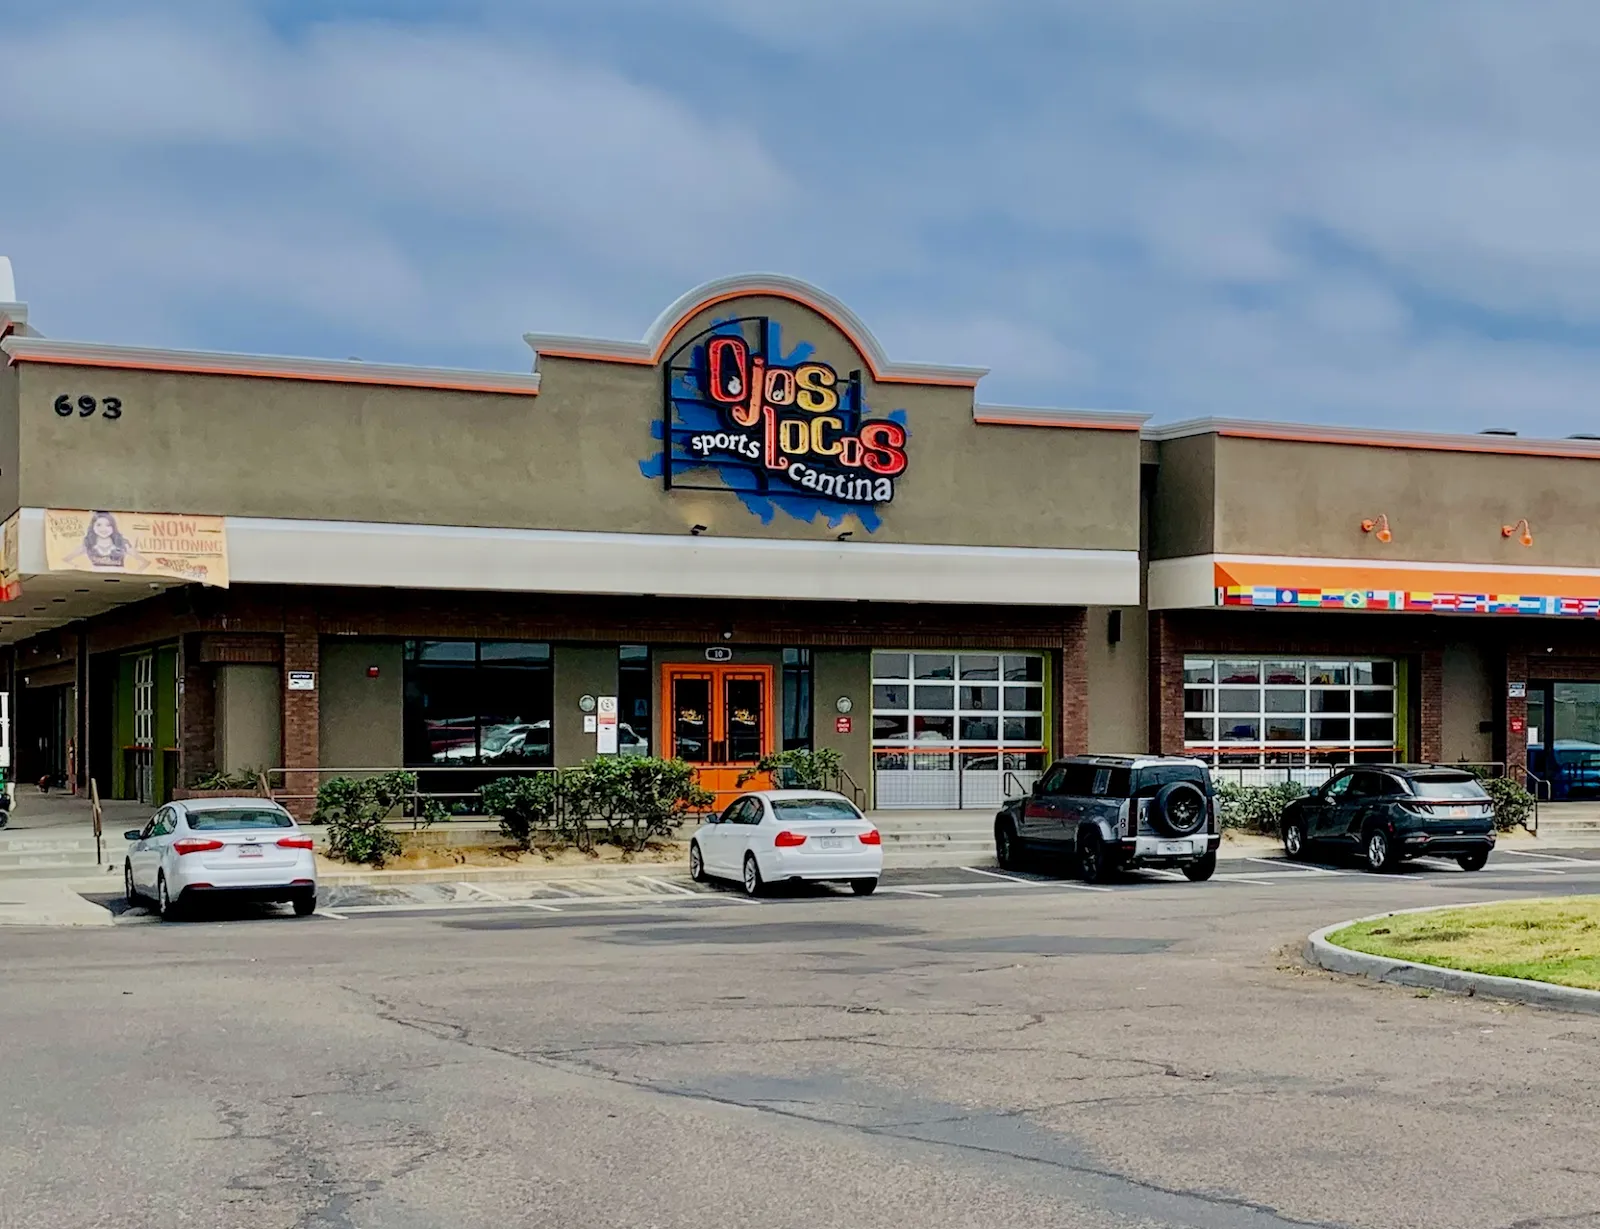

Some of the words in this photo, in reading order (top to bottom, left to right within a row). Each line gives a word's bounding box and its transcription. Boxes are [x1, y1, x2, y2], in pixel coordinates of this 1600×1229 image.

[54, 394, 122, 419] 693
[691, 432, 761, 459] sports
[788, 463, 894, 502] cantina
[152, 520, 197, 537] NOW
[134, 537, 223, 553] AUDITIONING
[714, 649, 724, 658] 10
